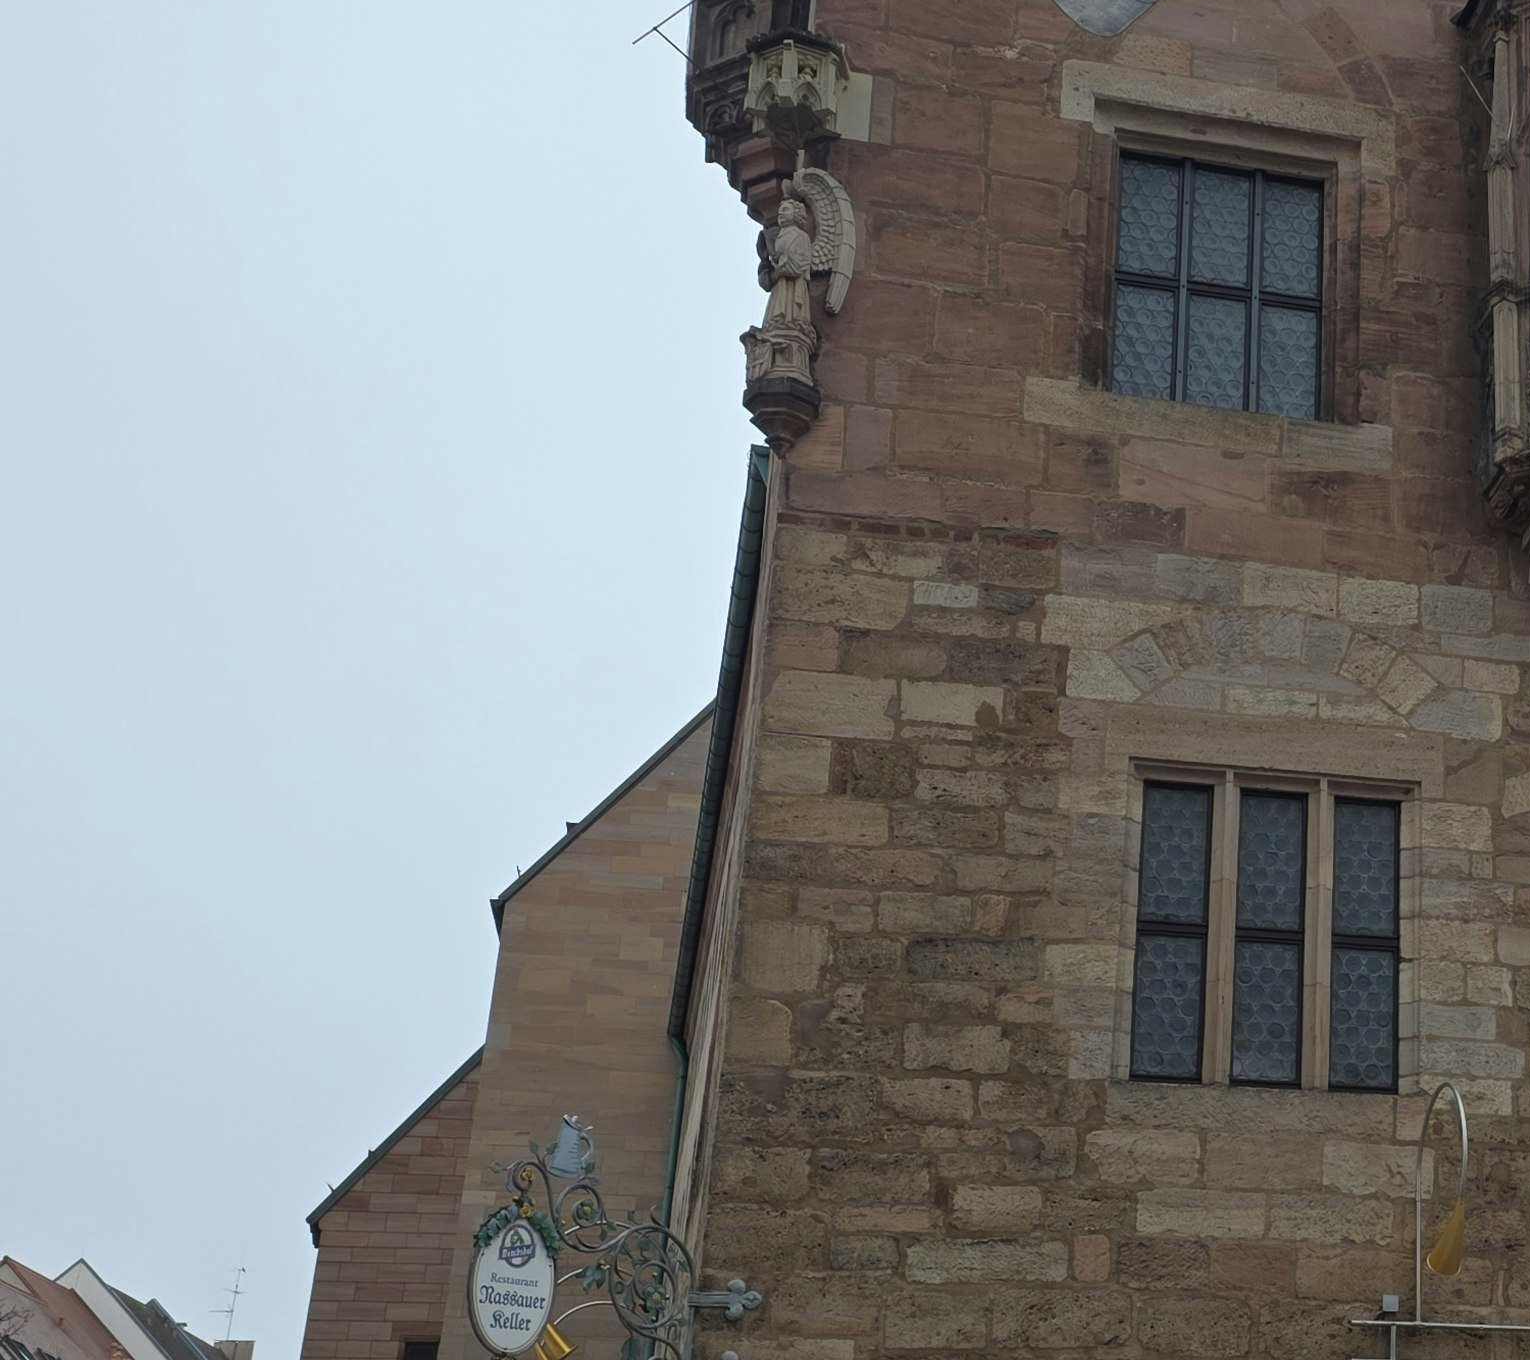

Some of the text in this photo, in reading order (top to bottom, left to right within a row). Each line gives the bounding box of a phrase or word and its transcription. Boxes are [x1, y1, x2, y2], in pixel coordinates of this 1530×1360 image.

[490, 1272, 538, 1288] Restaurant
[479, 1285, 545, 1309] Nassauer
[490, 1309, 531, 1331] Keller
